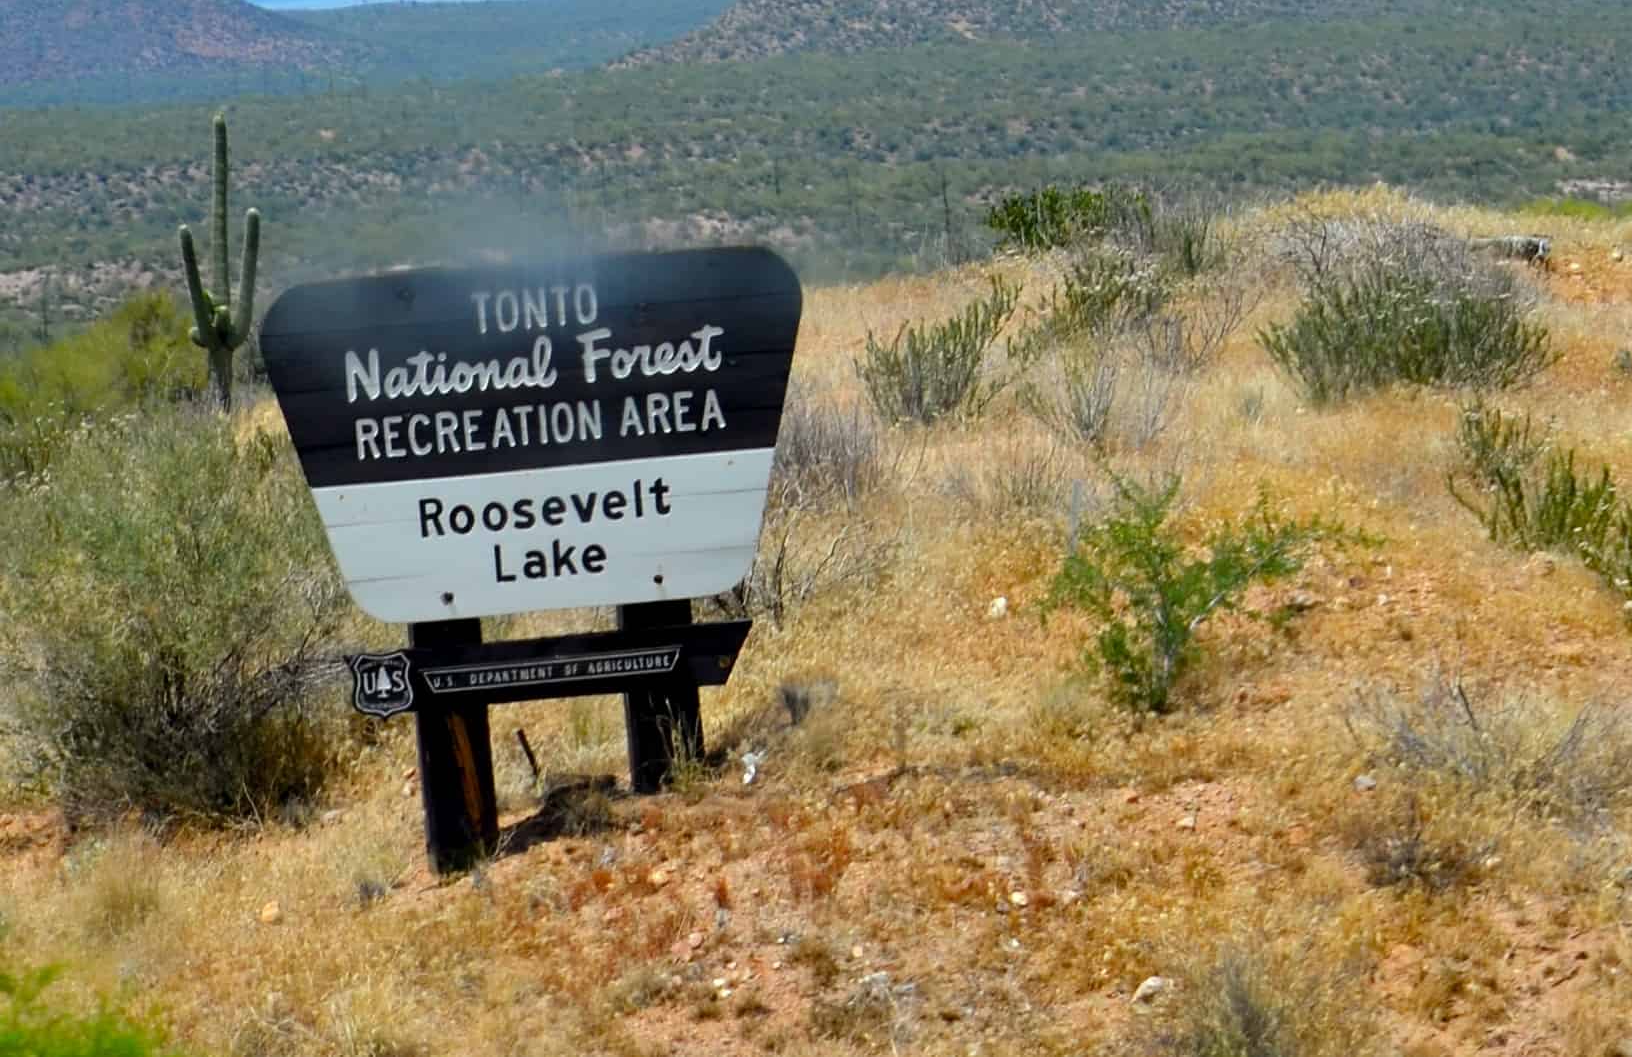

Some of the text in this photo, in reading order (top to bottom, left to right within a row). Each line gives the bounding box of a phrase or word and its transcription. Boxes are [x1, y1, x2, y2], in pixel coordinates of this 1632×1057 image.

[472, 284, 598, 334] TONTO
[344, 325, 725, 403] National Forest
[355, 389, 727, 461] RECREATION AREA
[418, 477, 671, 537] Roosevelt
[494, 539, 607, 583] Lake
[470, 666, 555, 685] DEPARTMENT
[564, 665, 578, 676] OF
[587, 654, 670, 675] AGRICULTURE
